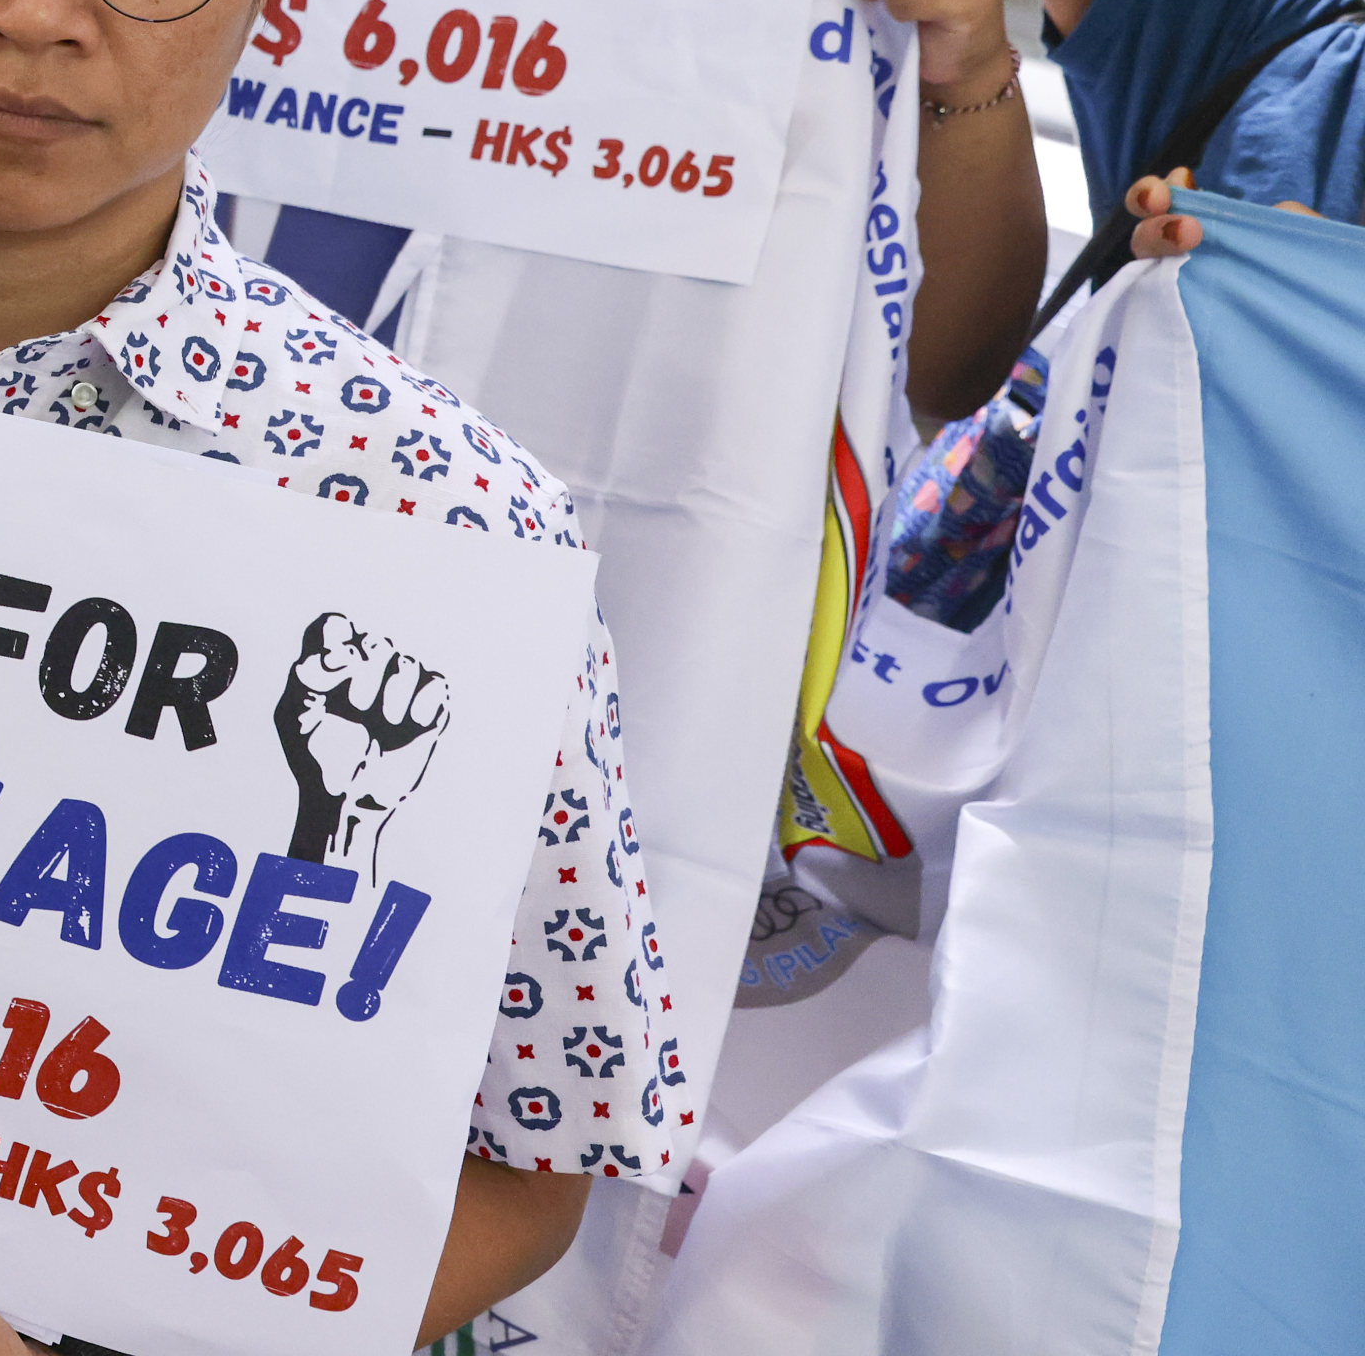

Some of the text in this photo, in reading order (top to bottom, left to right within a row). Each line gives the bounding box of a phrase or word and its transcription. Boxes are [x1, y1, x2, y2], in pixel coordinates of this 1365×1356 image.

[219, 75, 404, 145] WANCE
[470, 118, 571, 178] HK$
[591, 138, 736, 198] 3,065
[145, 1193, 365, 1314] 3,065
